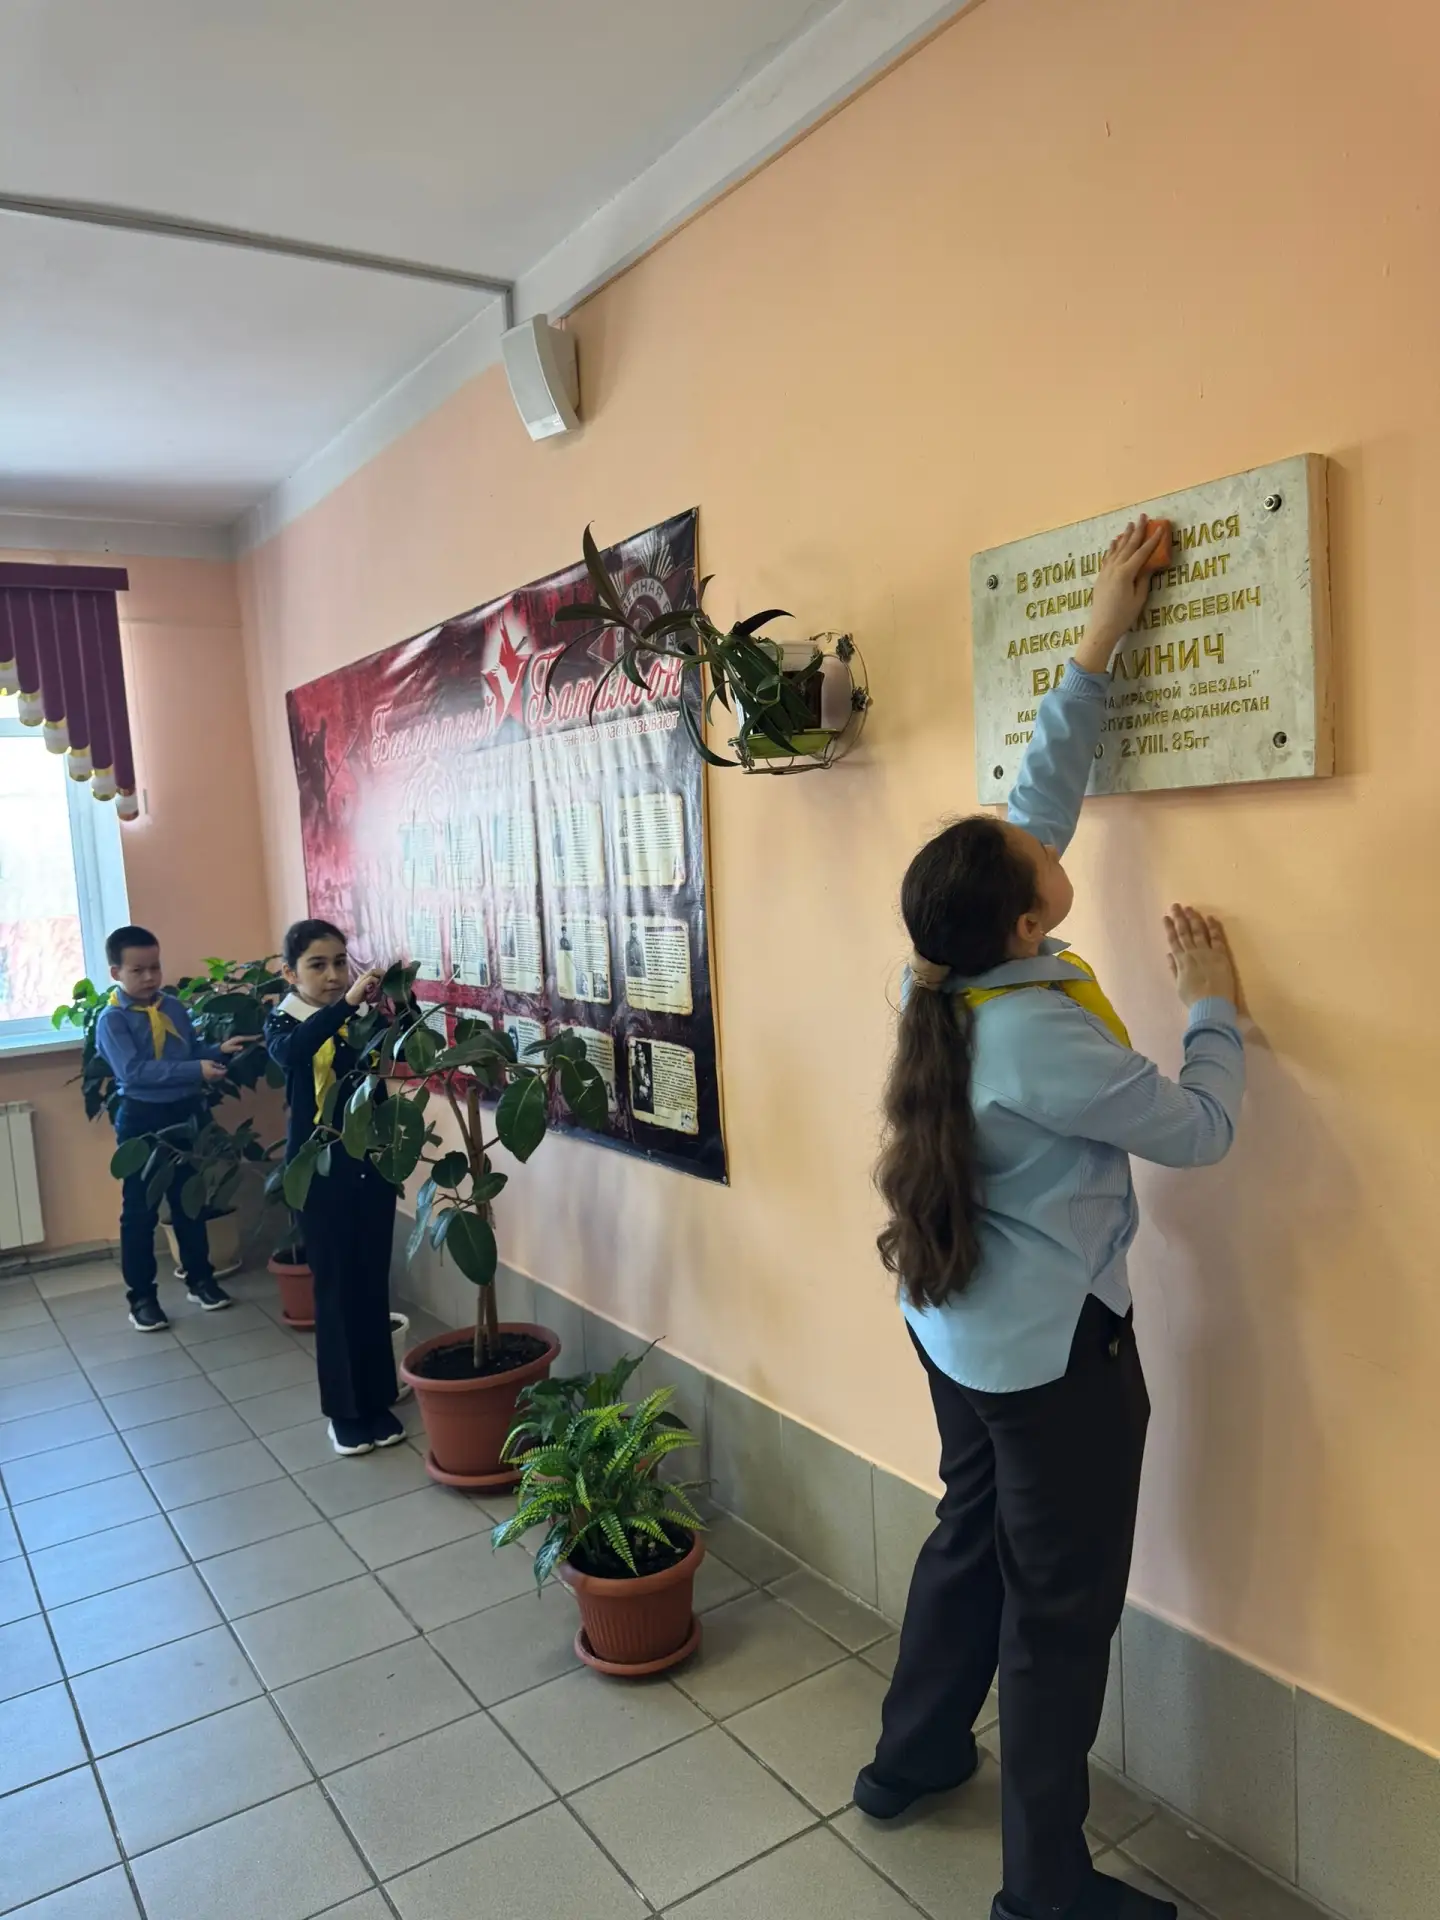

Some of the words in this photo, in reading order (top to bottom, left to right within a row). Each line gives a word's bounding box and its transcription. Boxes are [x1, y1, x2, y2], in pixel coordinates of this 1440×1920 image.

[1016, 571, 1028, 594] В
[1032, 553, 1076, 589] ЭТОЙ
[1171, 514, 1241, 552] ЧИЛСЯ
[1007, 624, 1085, 659] АЛЕКСАН
[1128, 585, 1262, 633] ЛЕКСЕЕВИЧ
[1025, 587, 1094, 620] СТАРШИ
[1172, 695, 1270, 723] АФГАНИСТАН
